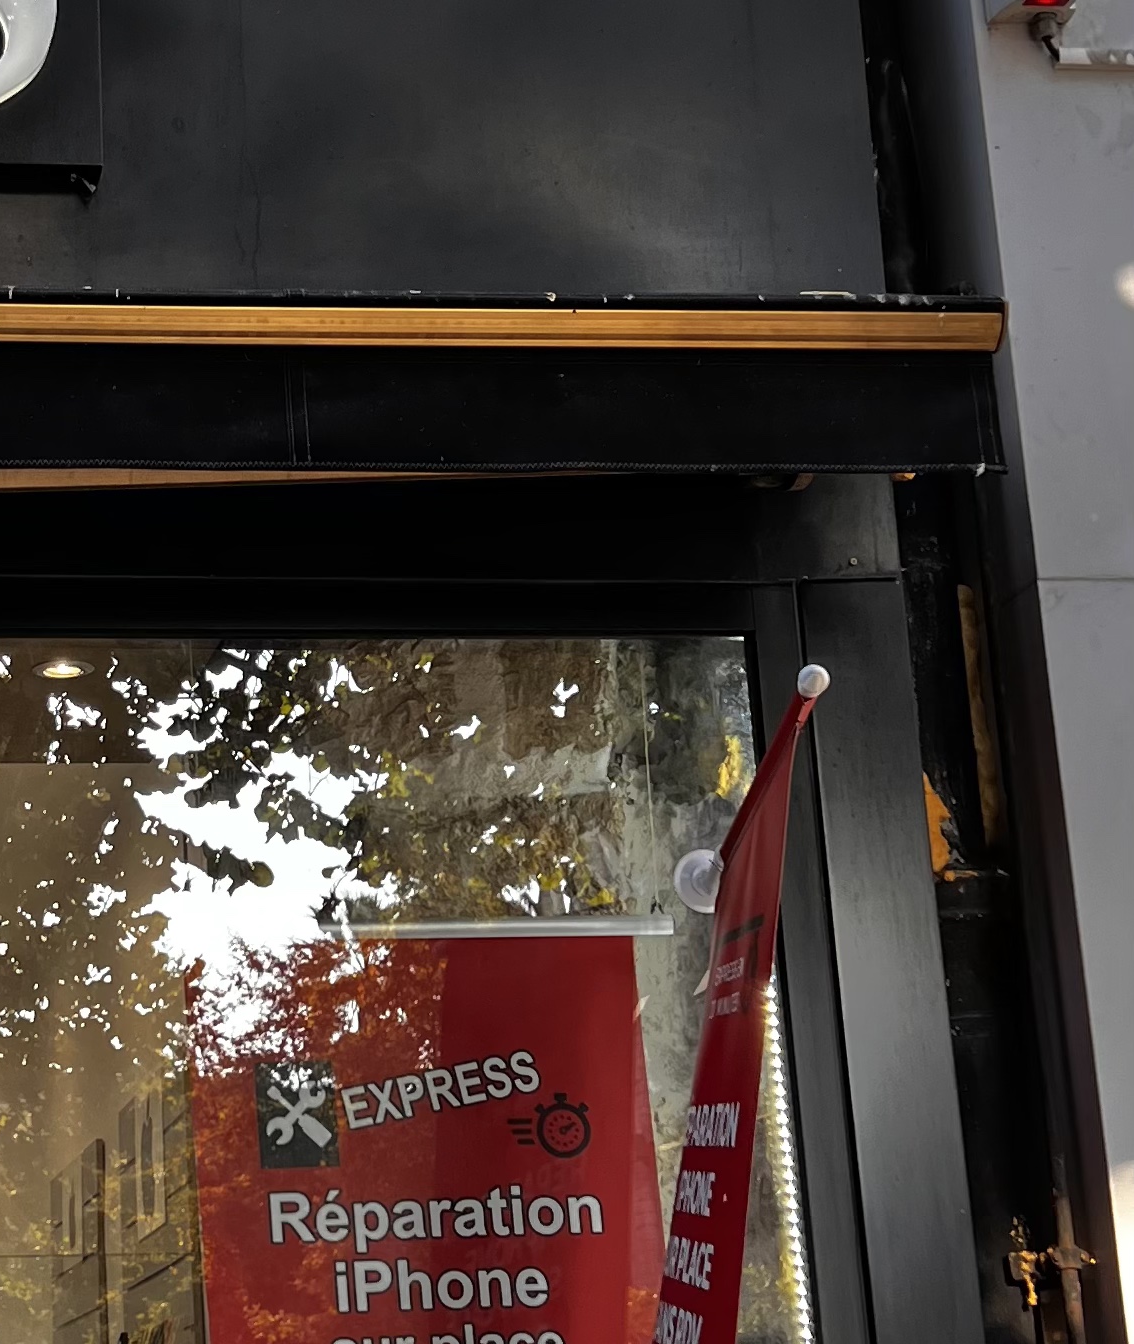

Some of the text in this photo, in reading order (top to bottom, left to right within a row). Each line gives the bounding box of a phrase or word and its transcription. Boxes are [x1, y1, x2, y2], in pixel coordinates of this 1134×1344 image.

[340, 1050, 541, 1131] EXPRESS
[267, 1184, 604, 1254] Réparation
[333, 1258, 550, 1313] iPhone
